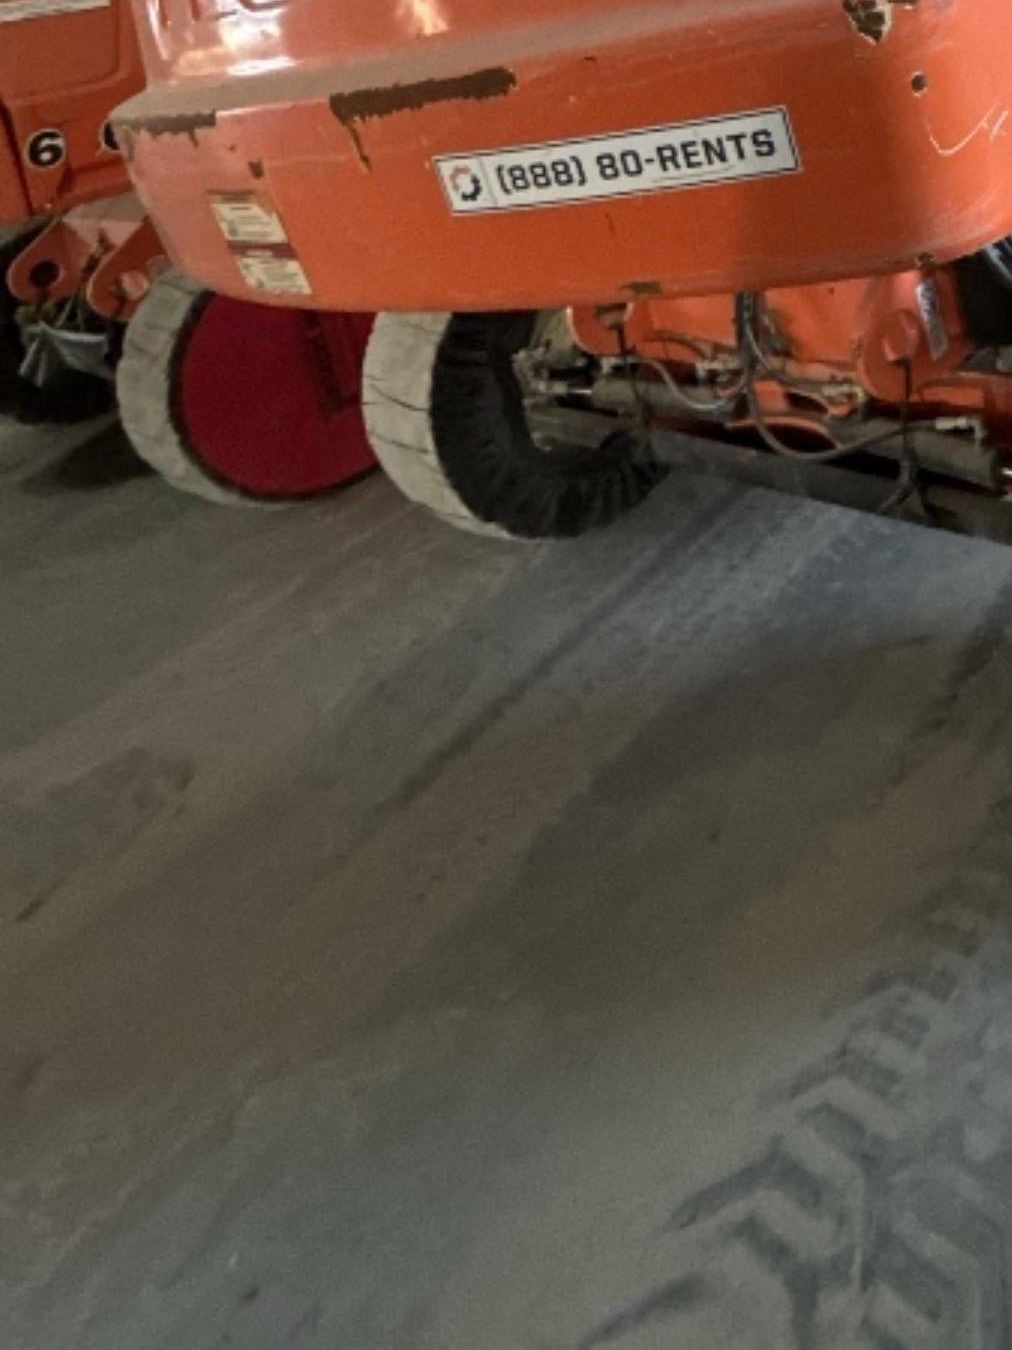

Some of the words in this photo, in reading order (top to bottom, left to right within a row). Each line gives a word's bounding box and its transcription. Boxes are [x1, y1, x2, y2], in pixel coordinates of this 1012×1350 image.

[27, 130, 65, 169] 6
[495, 154, 587, 196] (888)
[595, 128, 778, 182] 80-RENTS
